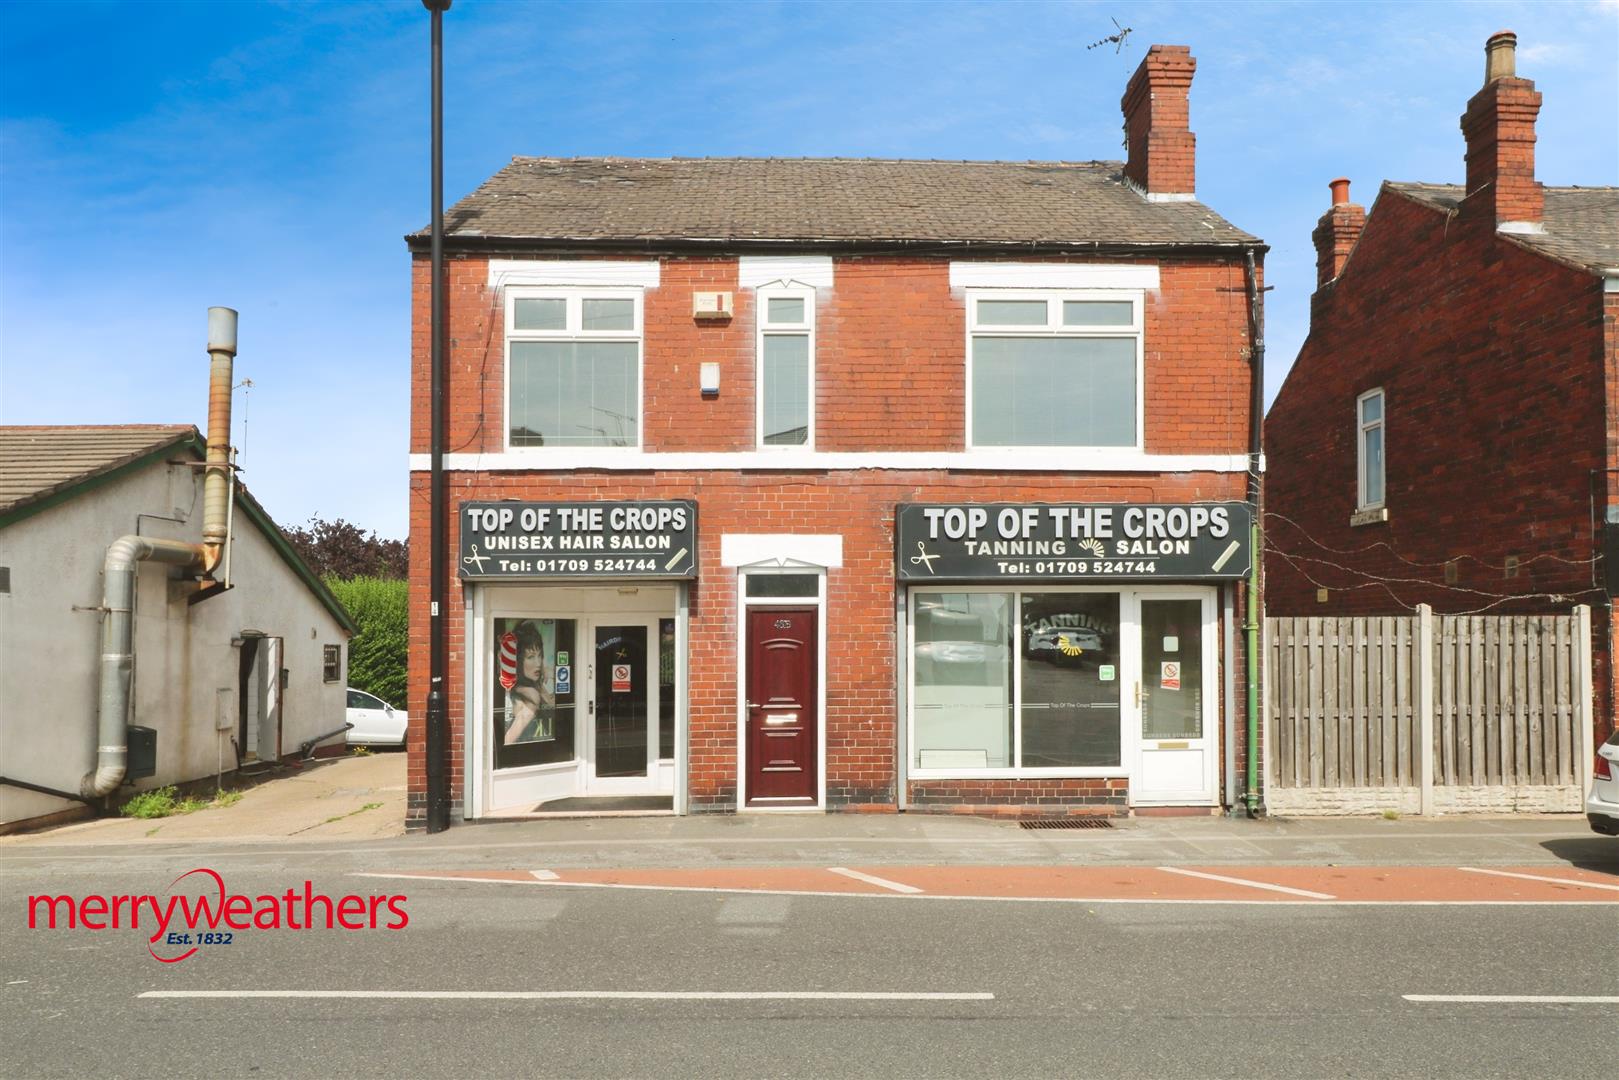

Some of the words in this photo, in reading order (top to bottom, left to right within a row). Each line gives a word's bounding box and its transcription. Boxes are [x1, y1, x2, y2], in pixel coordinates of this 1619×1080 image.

[468, 508, 514, 533] TOP
[520, 508, 551, 533] OF
[557, 508, 603, 532] THE
[610, 507, 687, 532] CROPS
[924, 508, 987, 539] TOP
[997, 508, 1039, 538] OF
[1049, 508, 1113, 538] THE
[1123, 507, 1229, 538] CROPS
[484, 536, 553, 550] UNISEX
[559, 536, 605, 550] HAIR
[610, 535, 671, 549] SALON
[964, 541, 1066, 556] TANNING
[1116, 540, 1190, 555] SALON
[499, 560, 531, 572] Tel:
[537, 559, 589, 571] 01709
[594, 559, 657, 571] 524744
[997, 562, 1030, 574] Tel:
[1035, 561, 1087, 574] 01709
[1093, 561, 1156, 573] 524744
[1024, 613, 1113, 634] TANNING
